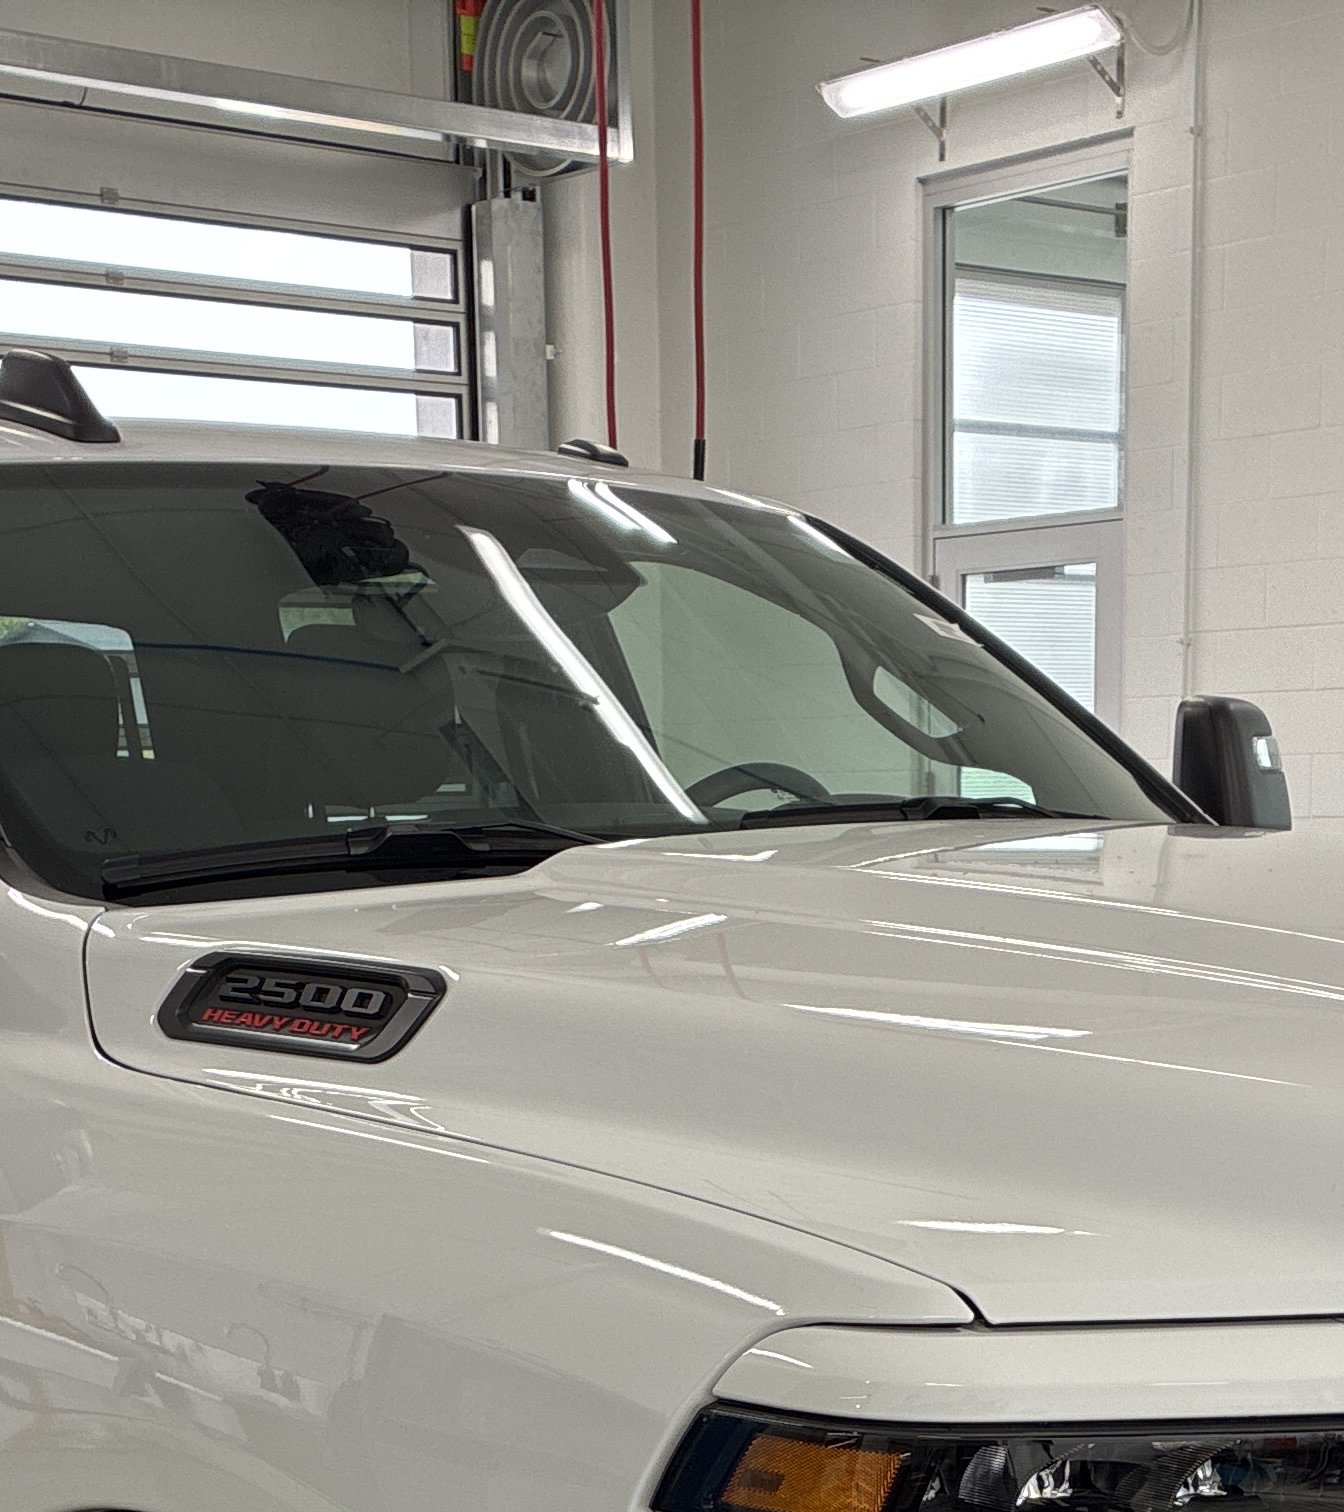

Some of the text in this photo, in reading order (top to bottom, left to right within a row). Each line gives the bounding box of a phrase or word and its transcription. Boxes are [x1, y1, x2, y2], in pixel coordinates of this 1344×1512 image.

[218, 974, 389, 1017] 2500
[201, 1006, 372, 1042] HEAVY DUTY
